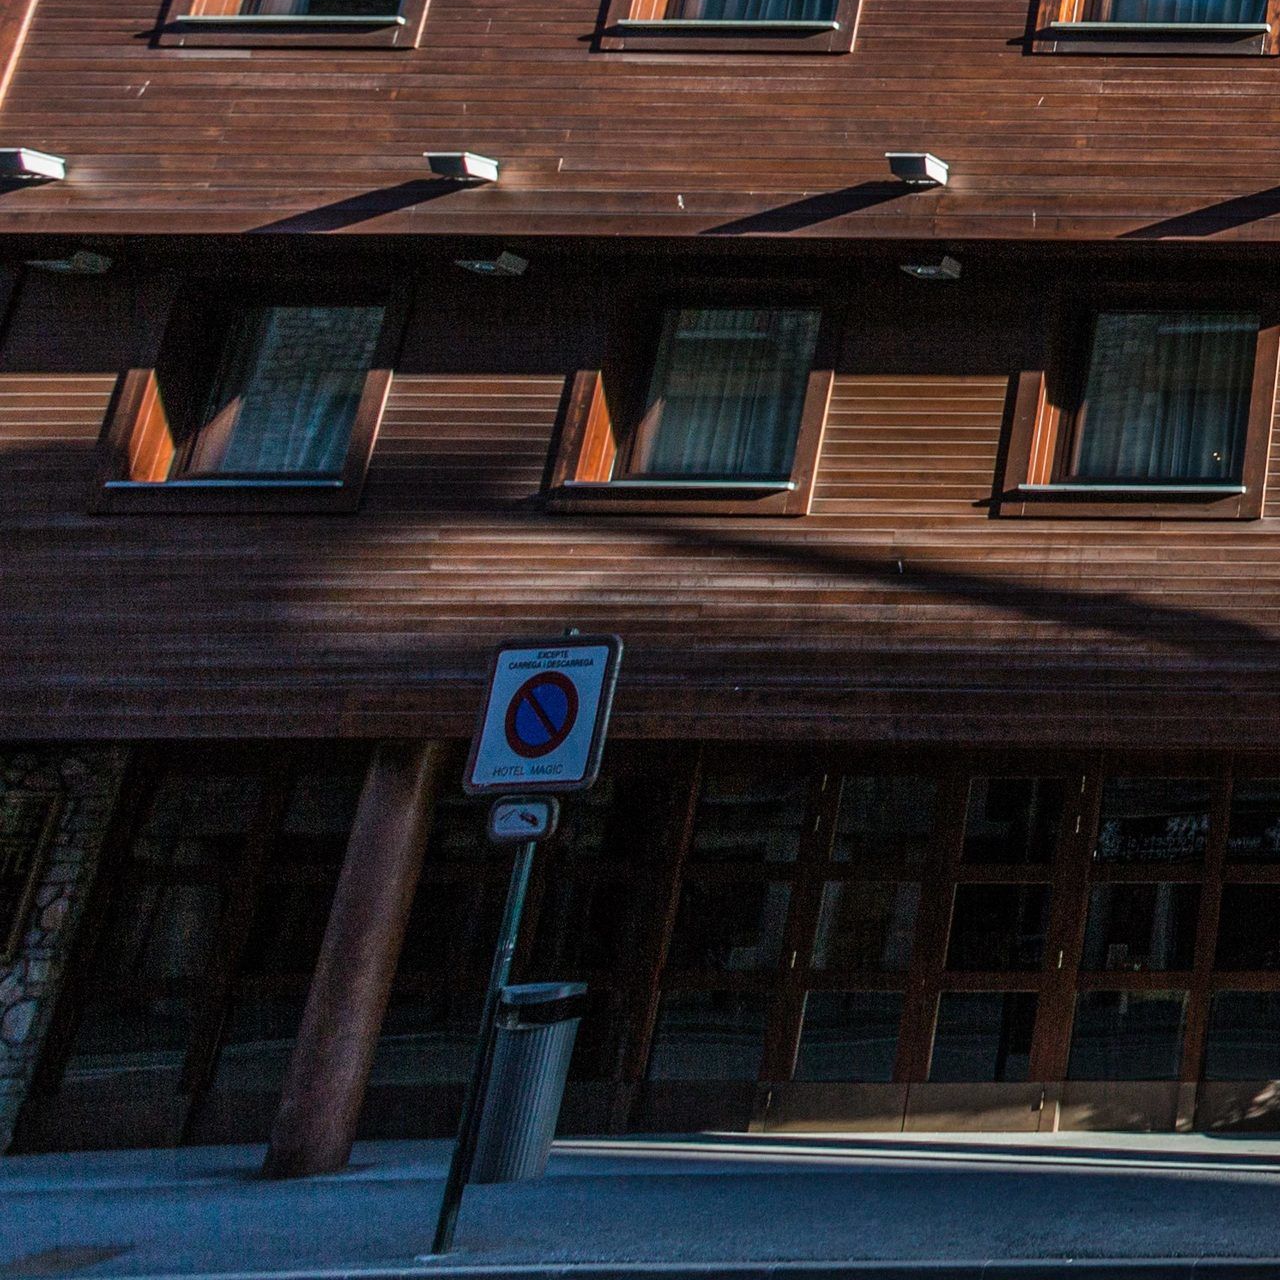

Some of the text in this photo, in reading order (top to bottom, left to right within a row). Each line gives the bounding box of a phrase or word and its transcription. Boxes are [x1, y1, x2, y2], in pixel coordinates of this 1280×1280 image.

[537, 650, 569, 659] EXCEPTE
[508, 660, 541, 670] CARREGA
[546, 658, 594, 669] DESCARREGA
[492, 765, 525, 777] HOTEL
